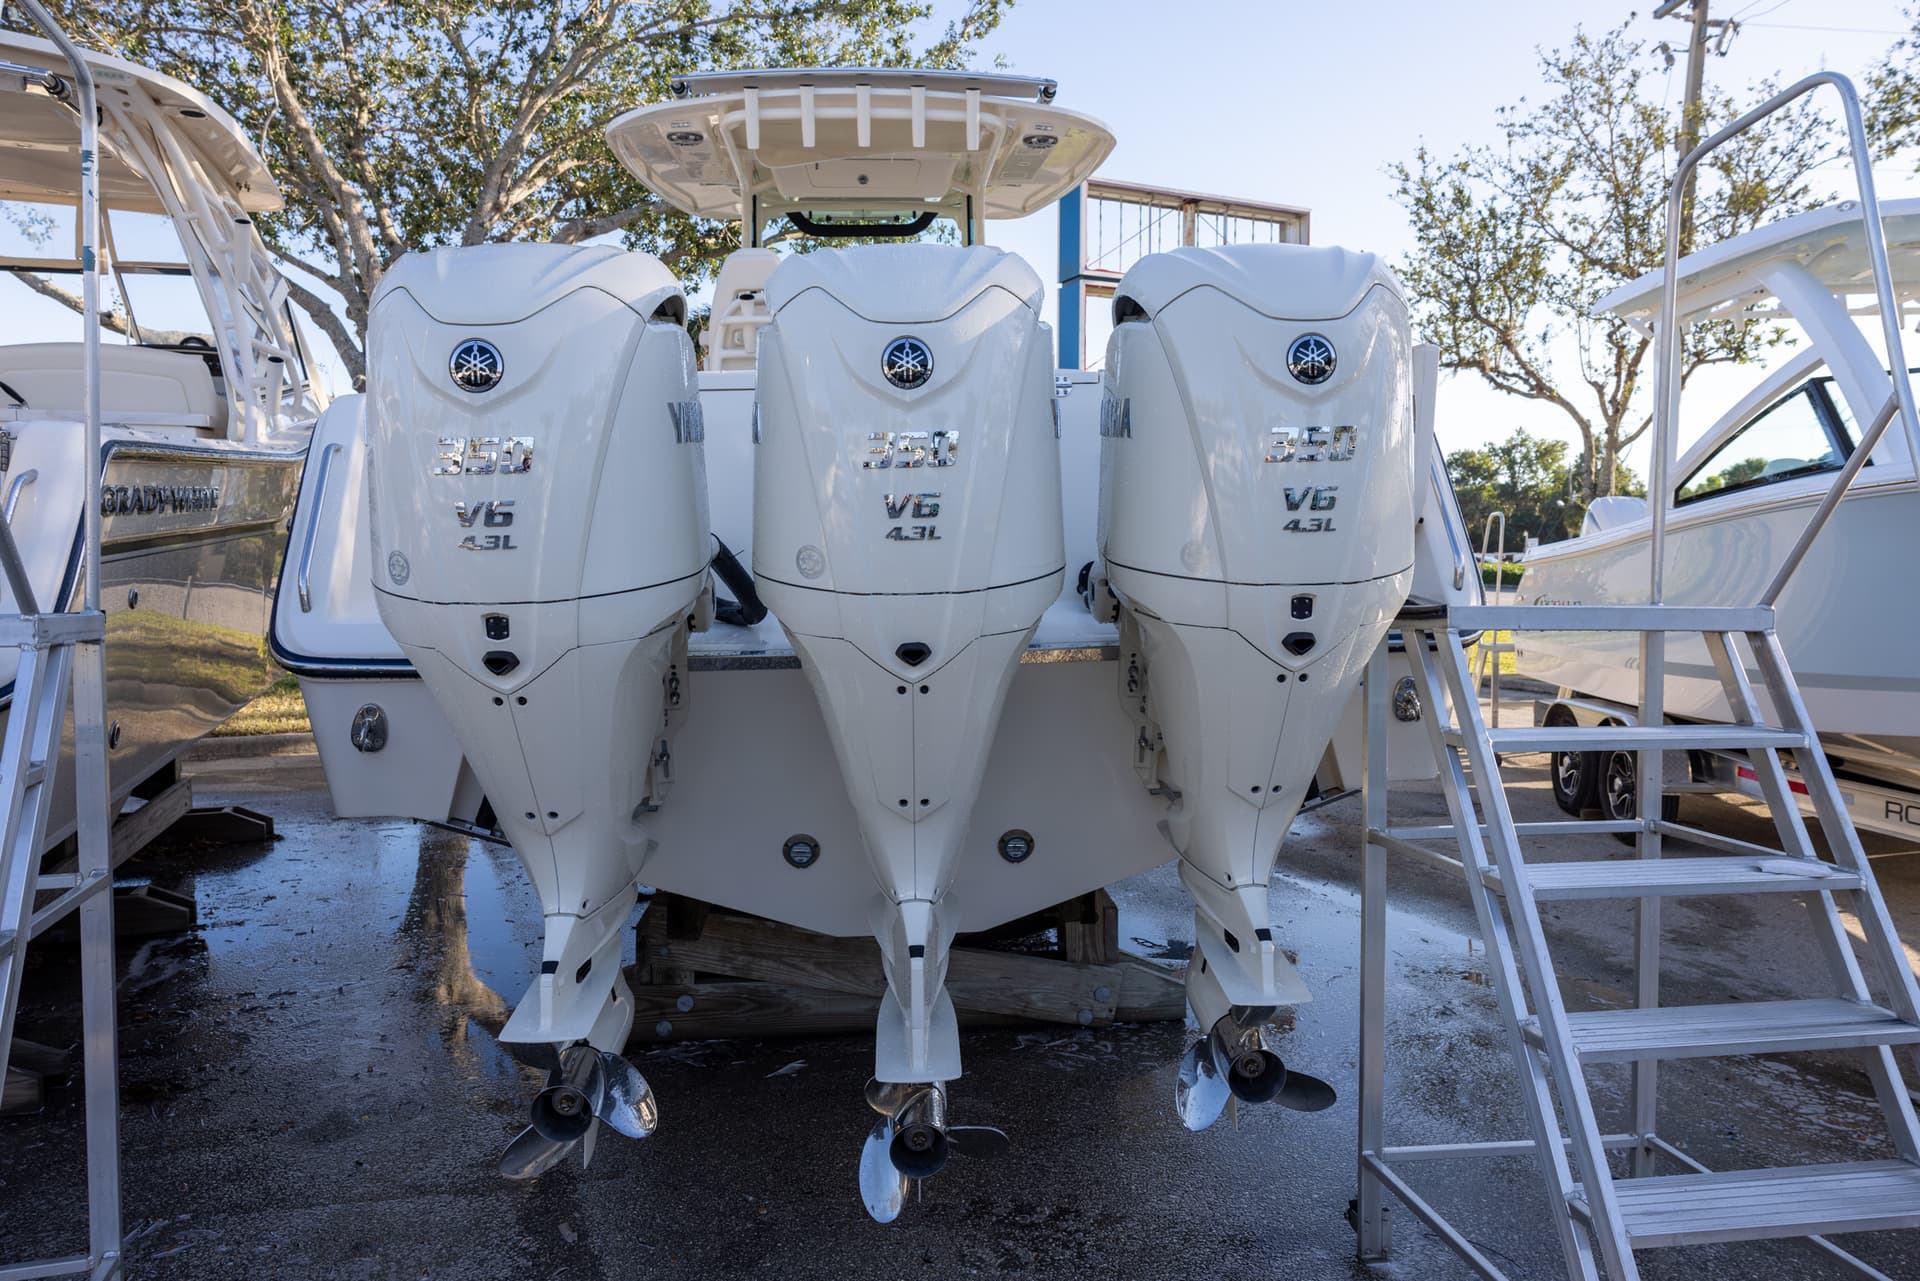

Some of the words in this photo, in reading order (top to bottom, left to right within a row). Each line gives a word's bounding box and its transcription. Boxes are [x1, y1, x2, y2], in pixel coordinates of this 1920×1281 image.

[434, 436, 534, 475] 350
[863, 430, 960, 469] 350
[1264, 425, 1358, 463] 350
[884, 492, 941, 518] V6
[1283, 486, 1338, 511] V6
[454, 500, 515, 527] V6
[1283, 518, 1337, 533] 4.3L
[457, 535, 518, 551] 4.3L
[885, 524, 942, 541] 4.3L
